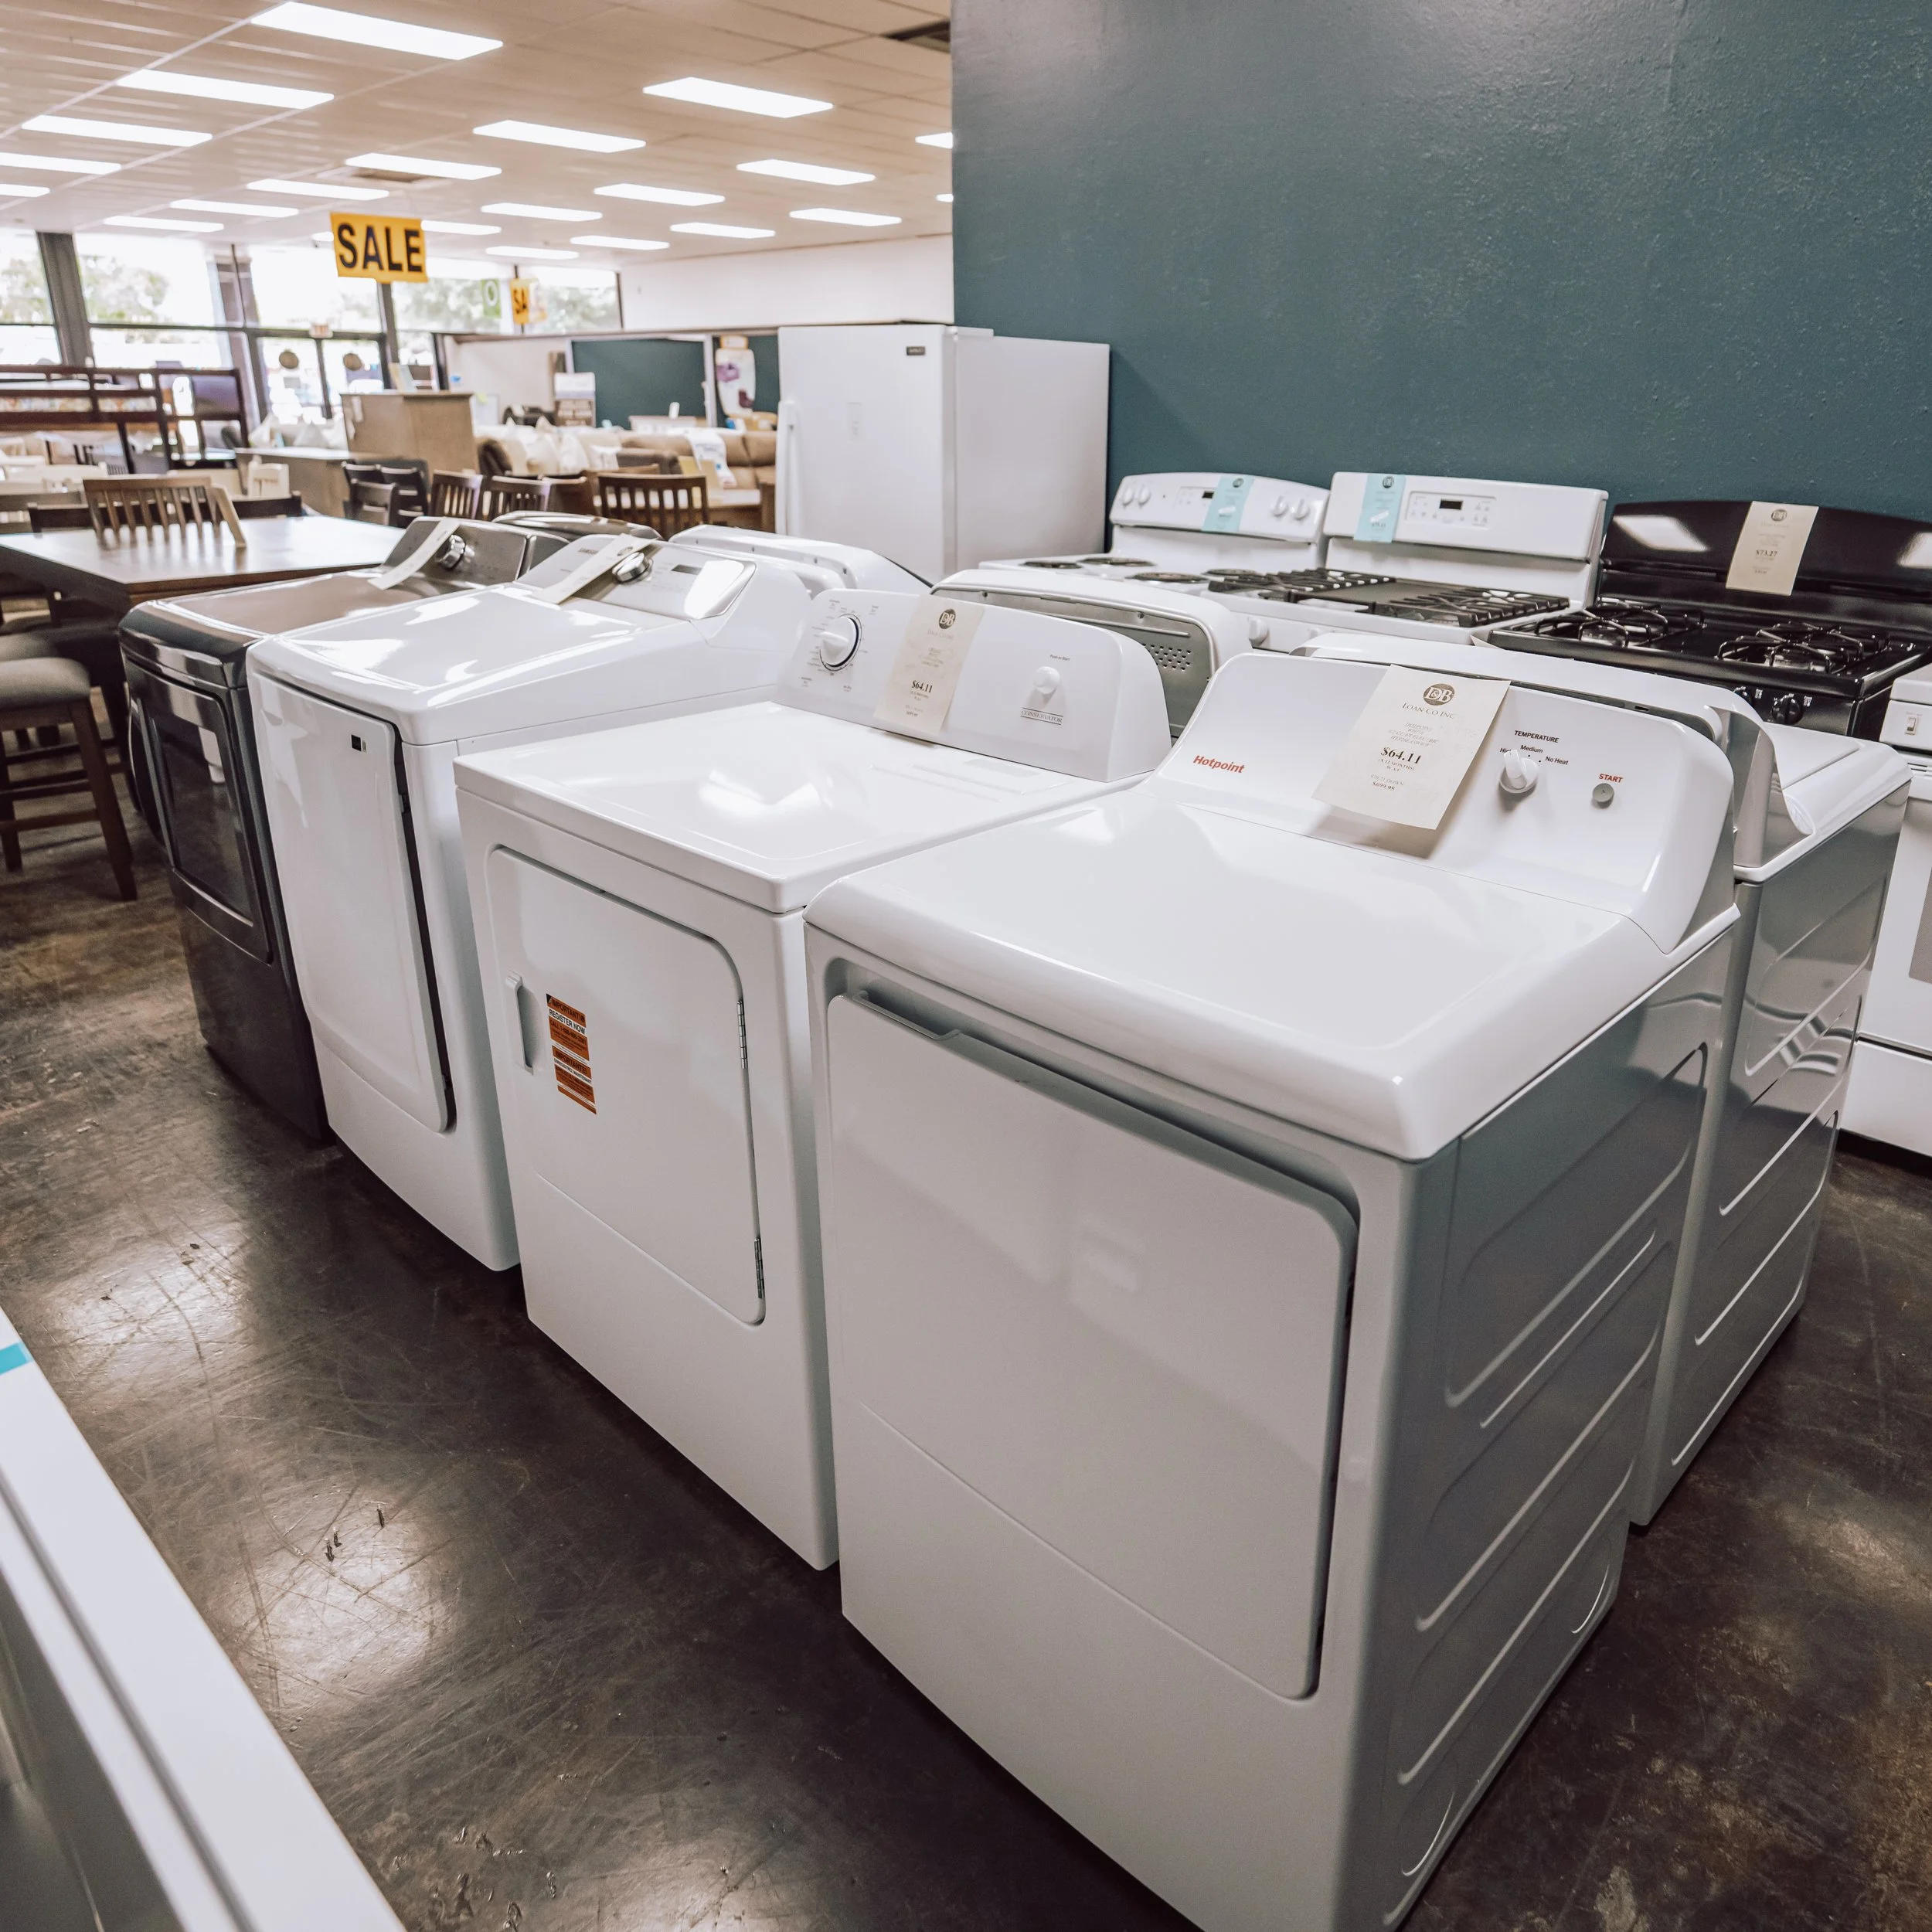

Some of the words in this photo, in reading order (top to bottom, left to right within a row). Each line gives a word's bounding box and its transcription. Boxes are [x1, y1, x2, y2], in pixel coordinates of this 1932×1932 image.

[337, 222, 423, 273] SALE
[911, 680, 933, 693] $64.11
[1021, 710, 1063, 723] CONSERVATOR
[1514, 730, 1560, 743] TEMPERATURE
[1519, 744, 1543, 753] Medium
[1379, 747, 1422, 764] $64.11
[1193, 755, 1245, 774] Hotpoint
[1598, 774, 1624, 784] START
[549, 1009, 573, 1028] REGISTER
[573, 1022, 586, 1035] NOW
